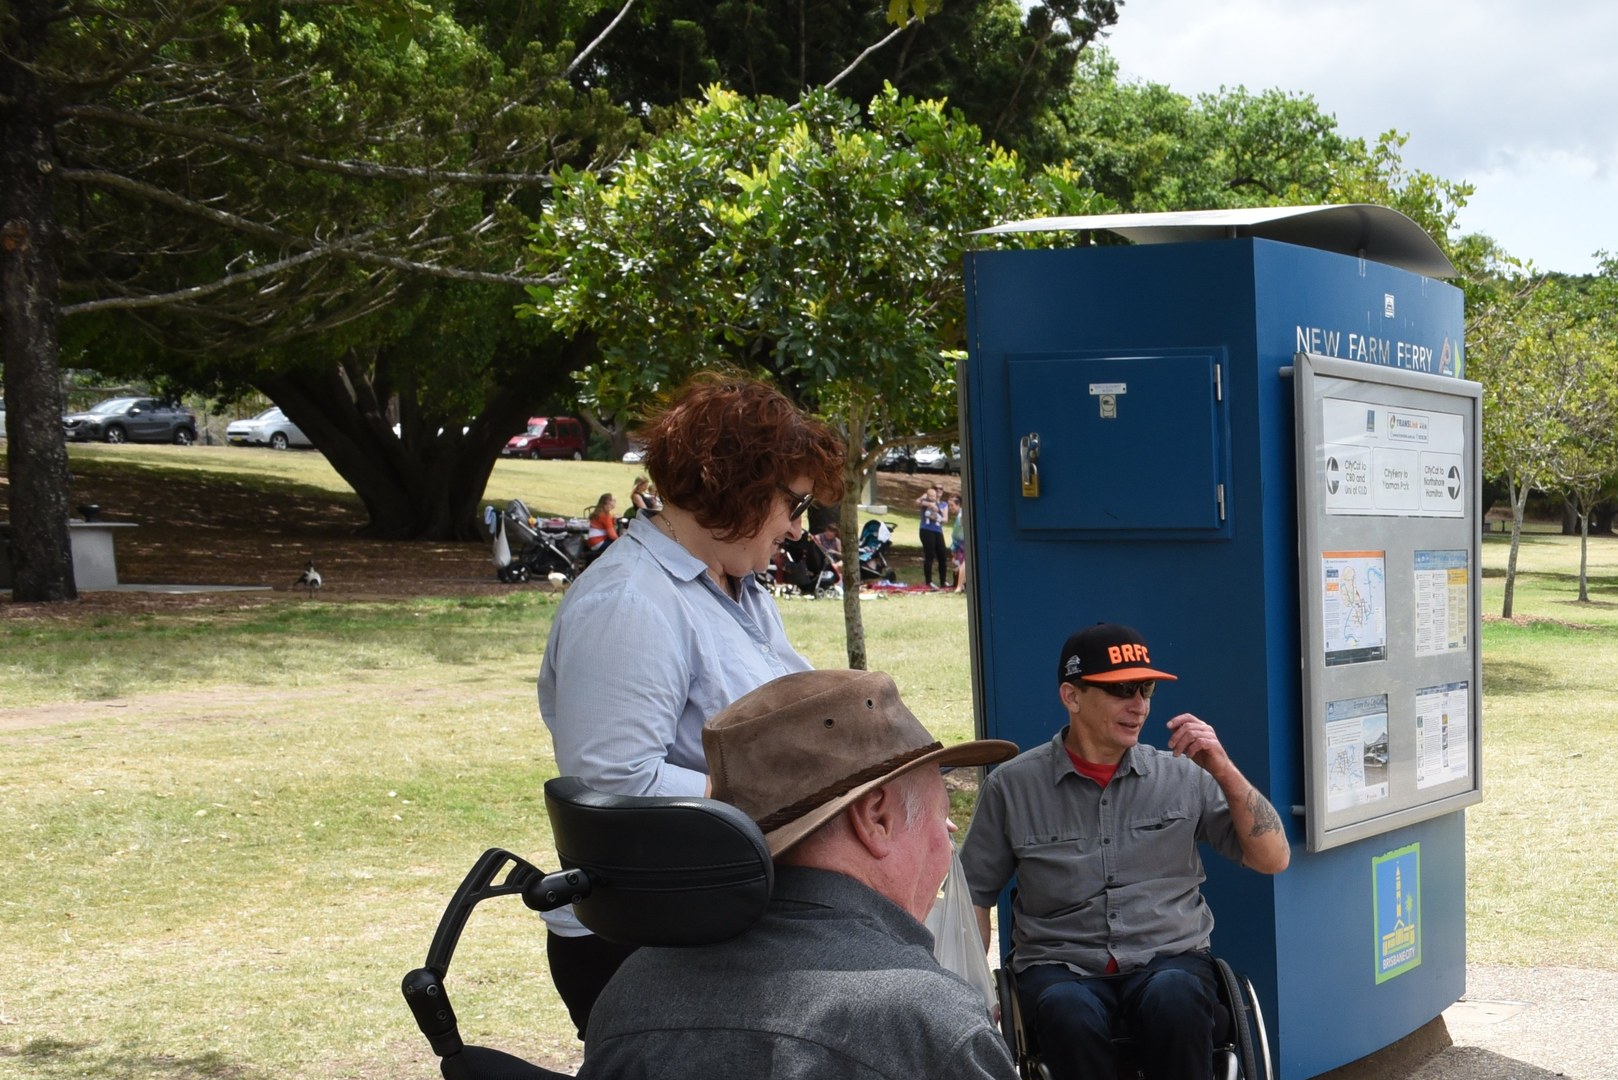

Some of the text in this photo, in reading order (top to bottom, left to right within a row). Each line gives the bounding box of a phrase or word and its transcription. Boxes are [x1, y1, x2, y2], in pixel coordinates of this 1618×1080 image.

[1296, 325, 1433, 372] NEW FARM FERRY
[1344, 460, 1360, 471] CityCat
[1424, 465, 1439, 476] CityCat
[1356, 474, 1366, 483] and
[1384, 468, 1402, 480] CityFerry
[1107, 643, 1150, 665] BRFC
[1382, 951, 1406, 970] BRISBANE
